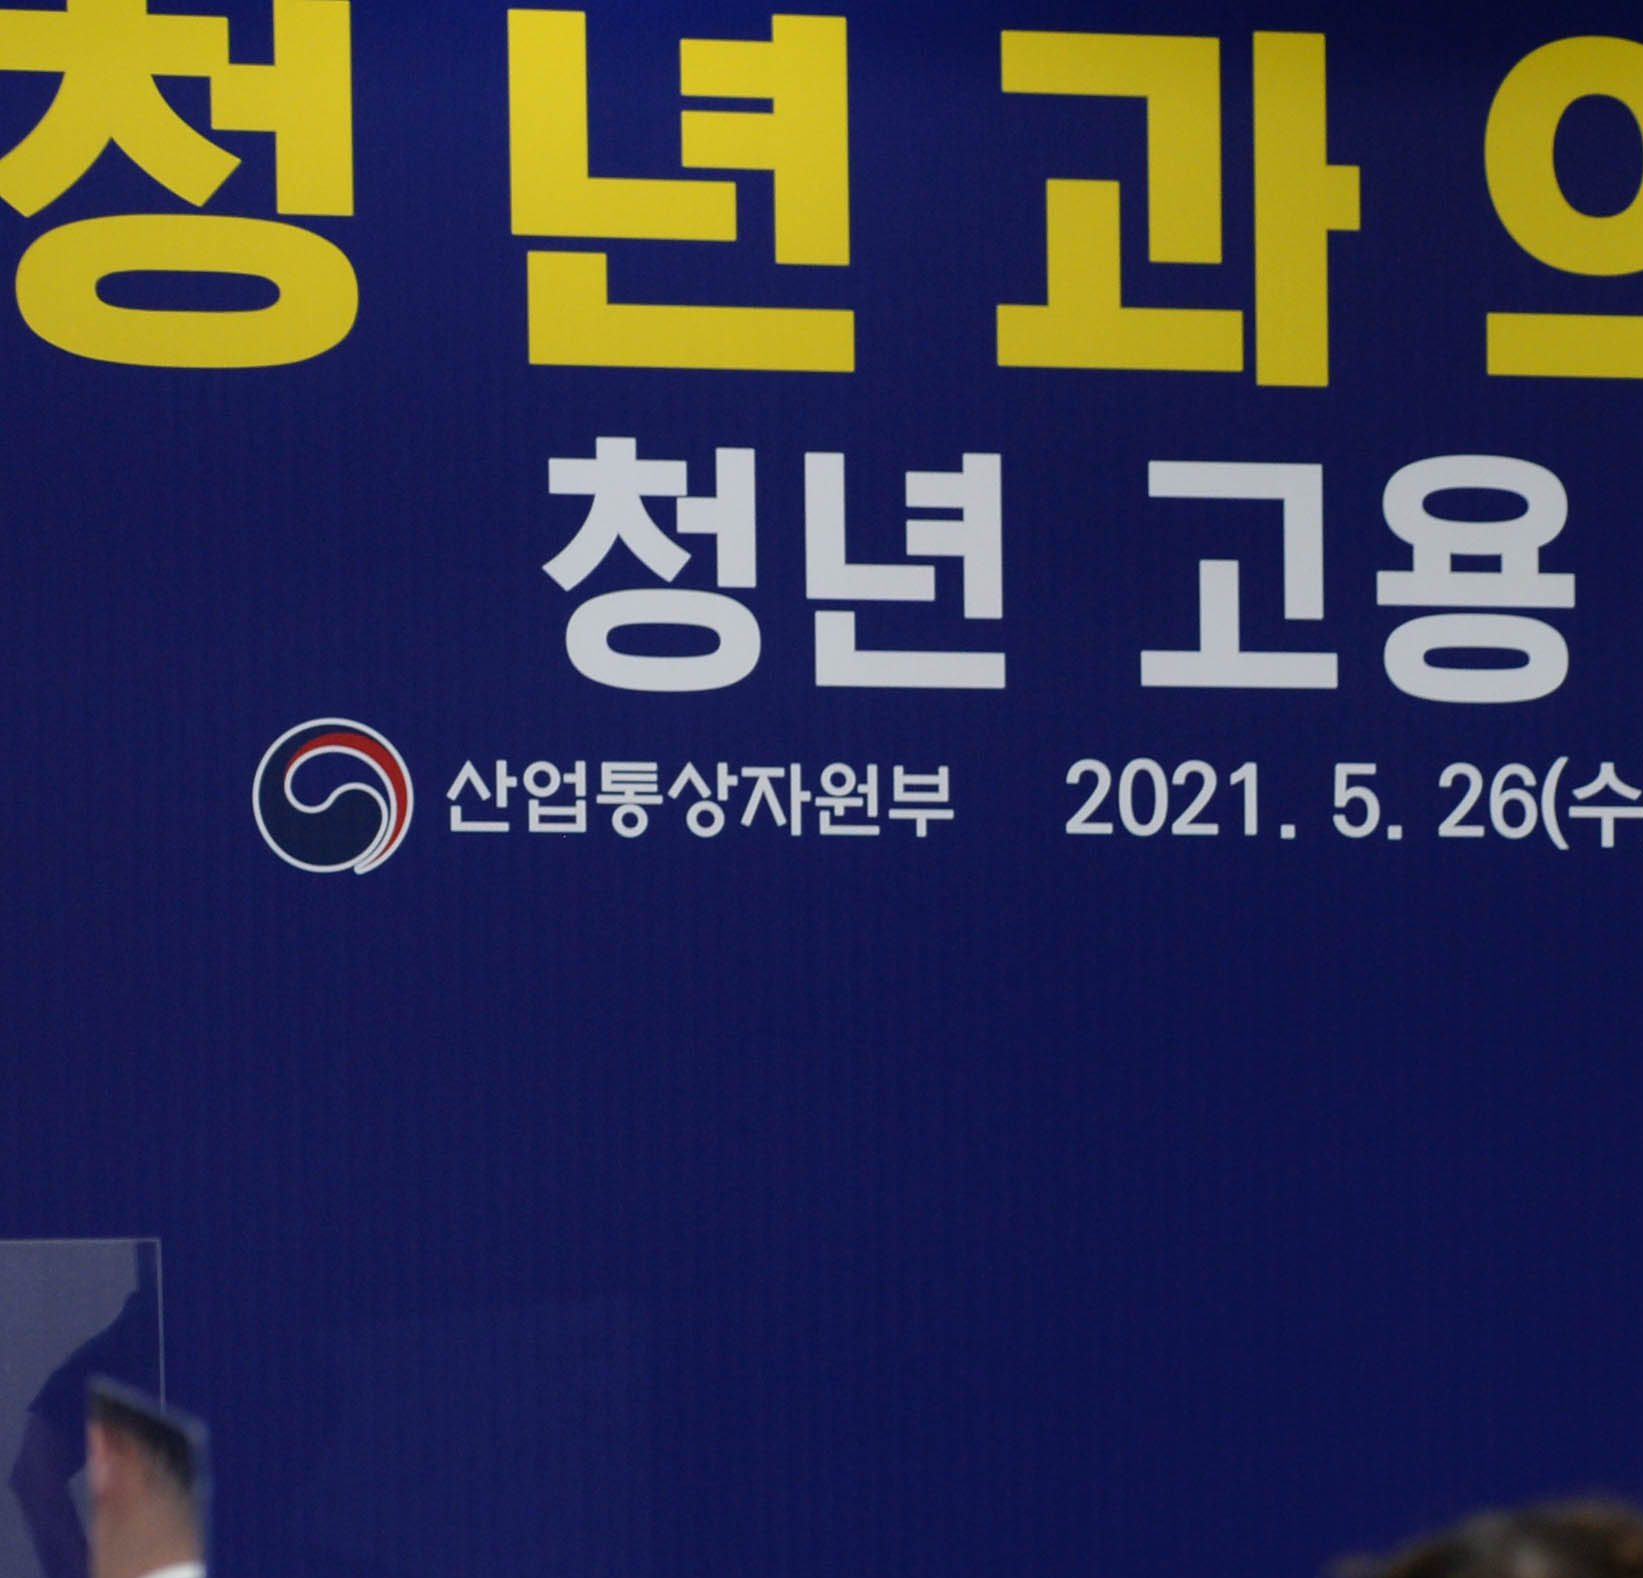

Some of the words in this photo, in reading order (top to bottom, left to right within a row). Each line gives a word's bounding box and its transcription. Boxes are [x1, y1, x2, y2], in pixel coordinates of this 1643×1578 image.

[541, 435, 1007, 693] 청년
[1140, 454, 1576, 704] 고용
[446, 759, 955, 839] 산업통상자원부
[1065, 757, 1296, 840] 2021.
[1332, 762, 1403, 841] 5.
